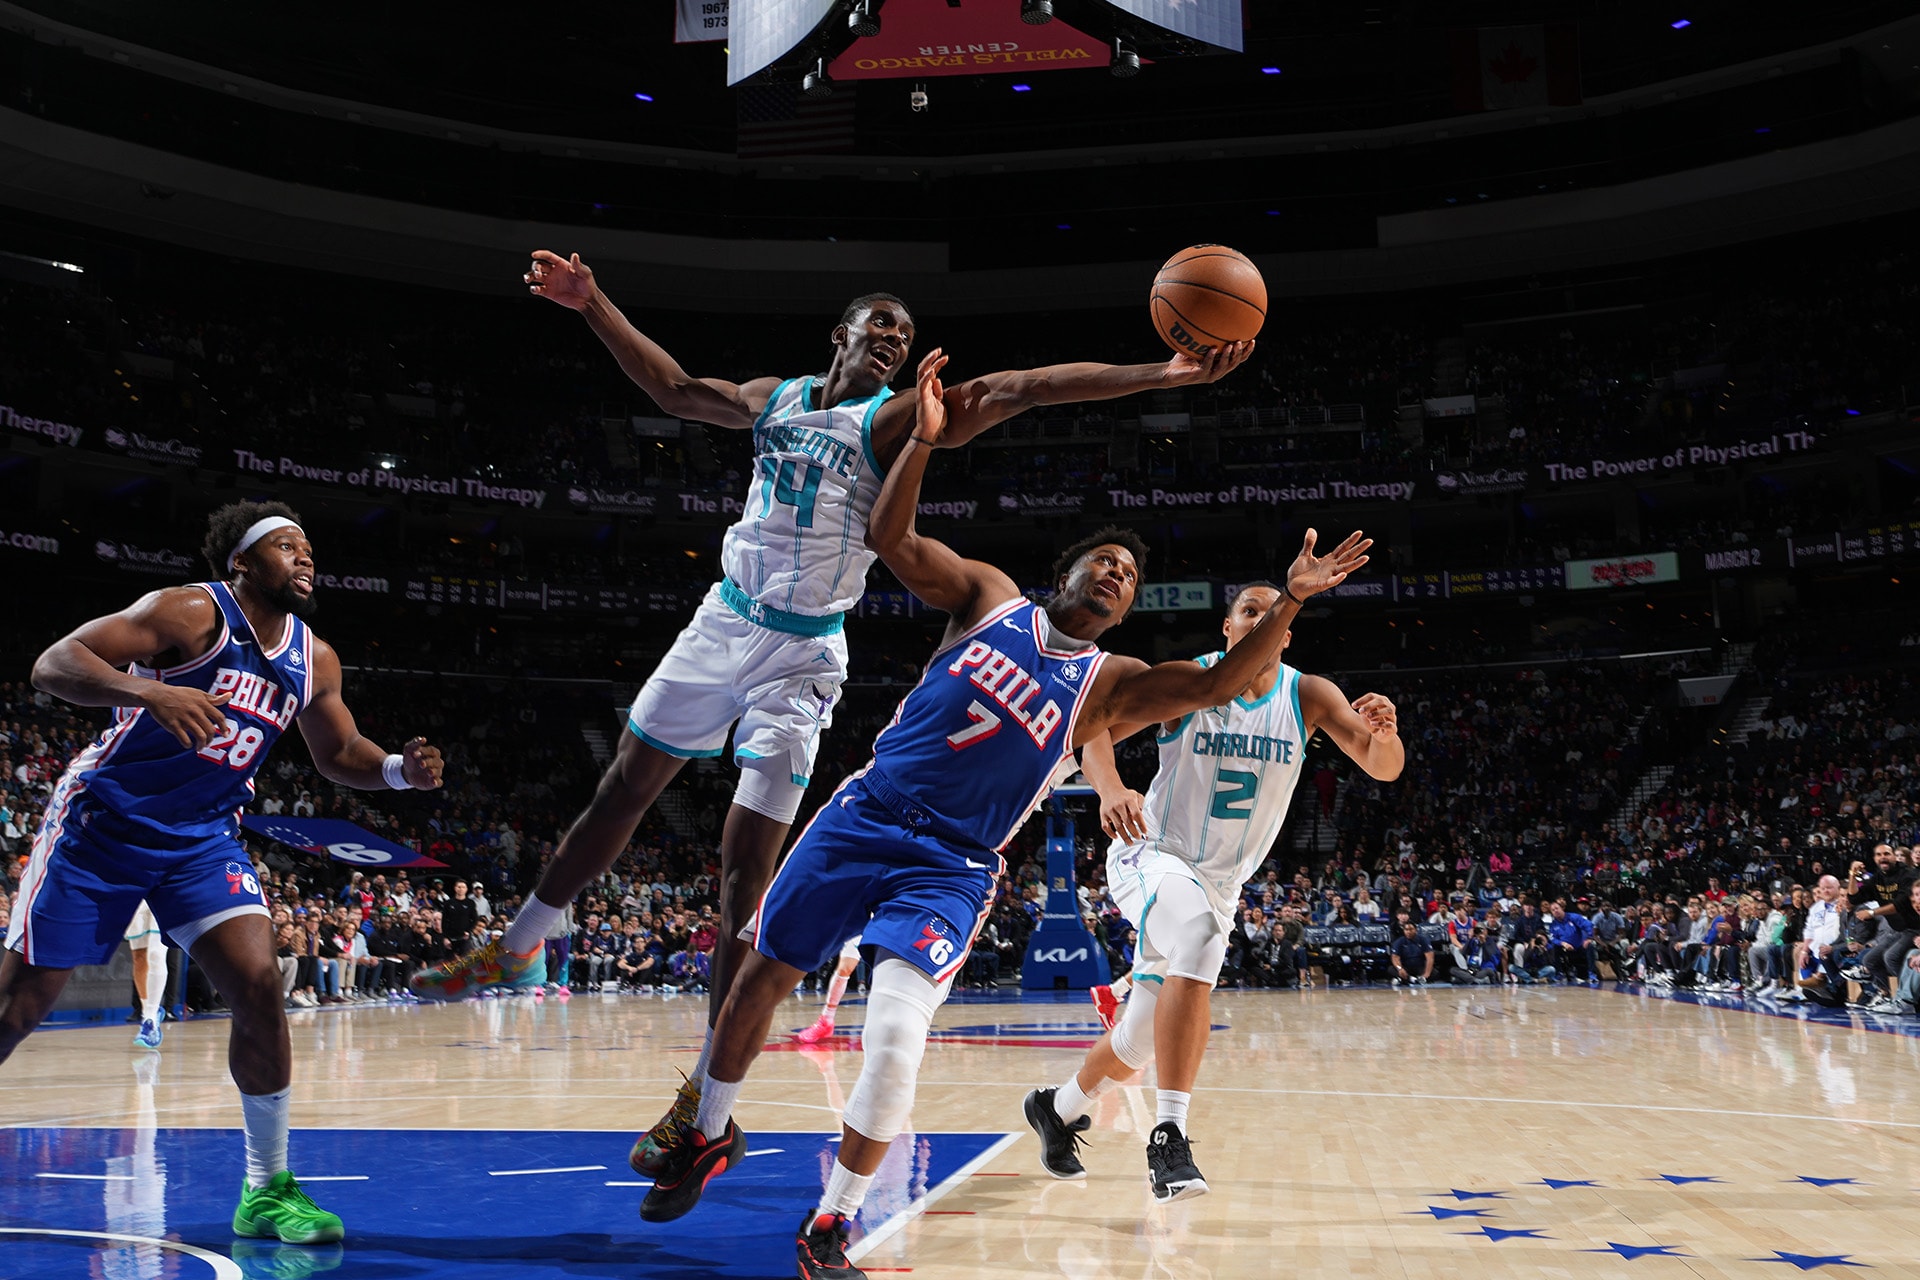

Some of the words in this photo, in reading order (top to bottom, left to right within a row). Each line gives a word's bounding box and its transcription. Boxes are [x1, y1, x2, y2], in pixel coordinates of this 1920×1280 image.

[703, 16, 728, 28] 1973
[854, 55, 965, 70] FARGO
[919, 42, 1019, 56] CENTER
[975, 48, 1091, 65] WELLS
[755, 426, 858, 479] CHARLOTTE
[1544, 462, 1588, 482] The
[1592, 456, 1658, 478] Power
[1661, 448, 1685, 467] of
[1689, 434, 1782, 465] Physical
[233, 449, 275, 474] The
[278, 456, 344, 484] Power
[346, 467, 370, 486] of
[374, 469, 460, 496] Physical
[462, 478, 547, 510] Therapy
[758, 457, 824, 529] 14
[1107, 489, 1148, 508] The
[1151, 488, 1214, 506] Power
[1217, 485, 1240, 504] of
[1243, 481, 1327, 506] Physical
[1329, 480, 1416, 501] Therapy
[678, 493, 718, 513] The
[1704, 549, 1750, 572] MARCH
[1751, 548, 1762, 566] 2
[1405, 585, 1416, 598] 4
[1427, 584, 1437, 597] 2
[870, 603, 881, 616] 2
[891, 603, 902, 616] 2
[208, 667, 299, 733] PHILA
[948, 639, 1063, 751] PHILA
[947, 699, 1002, 752] 7
[197, 718, 265, 772] 28
[1193, 732, 1294, 765] CHARLOTTE
[1210, 768, 1259, 820] 2
